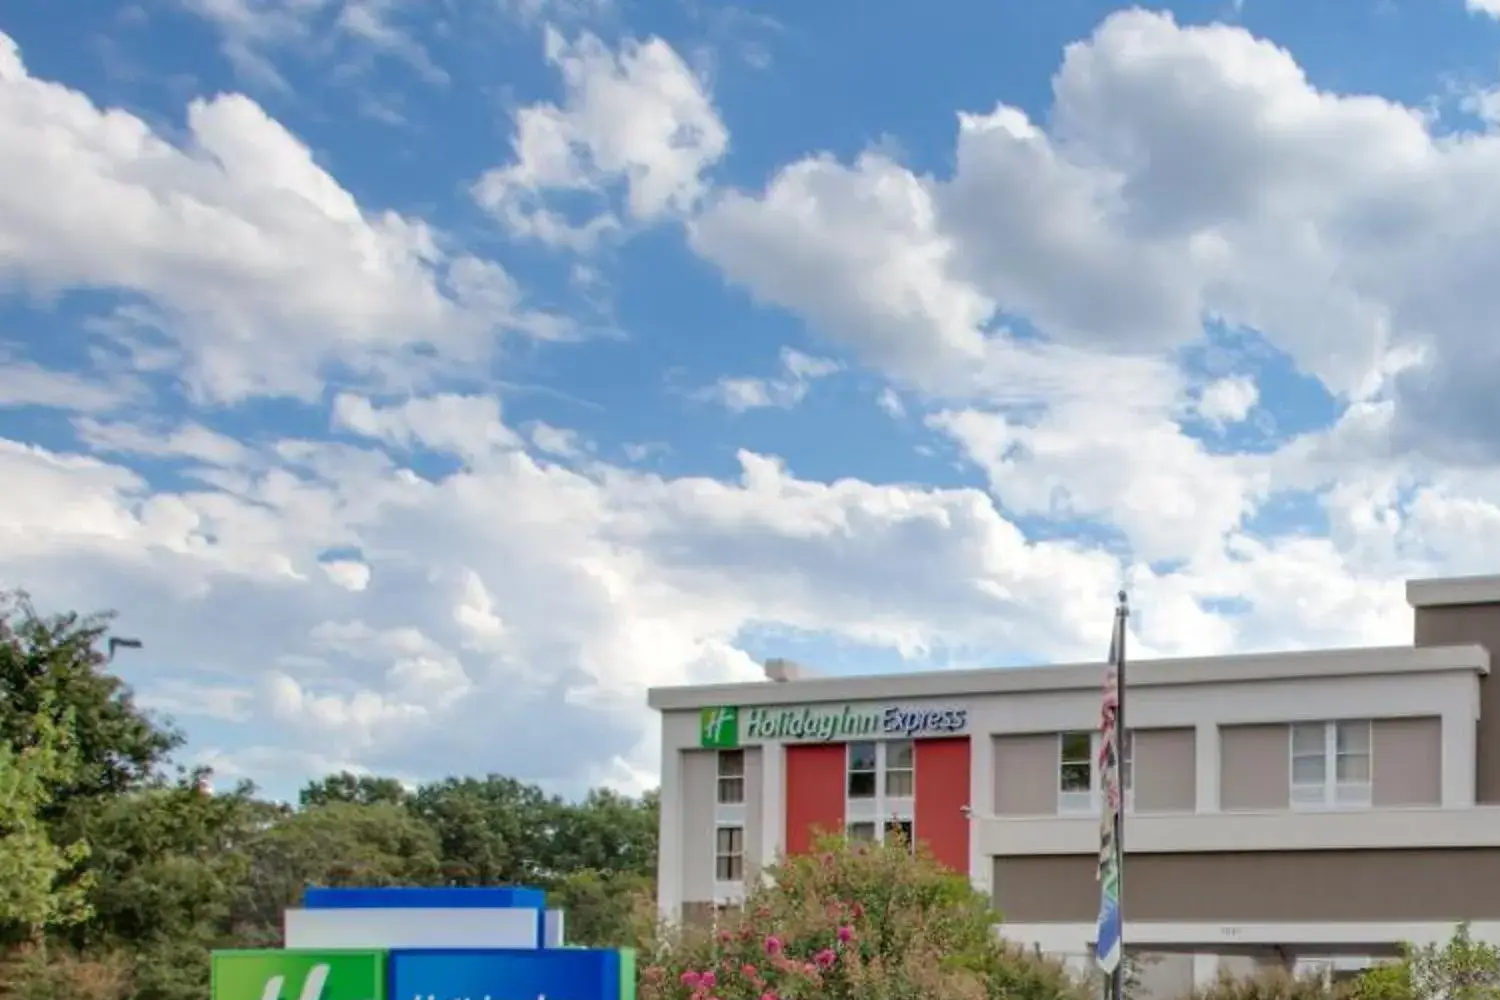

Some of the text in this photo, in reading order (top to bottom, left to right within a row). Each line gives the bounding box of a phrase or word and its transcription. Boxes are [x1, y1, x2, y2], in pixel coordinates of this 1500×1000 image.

[746, 705, 968, 741] Holiday Inn Express
